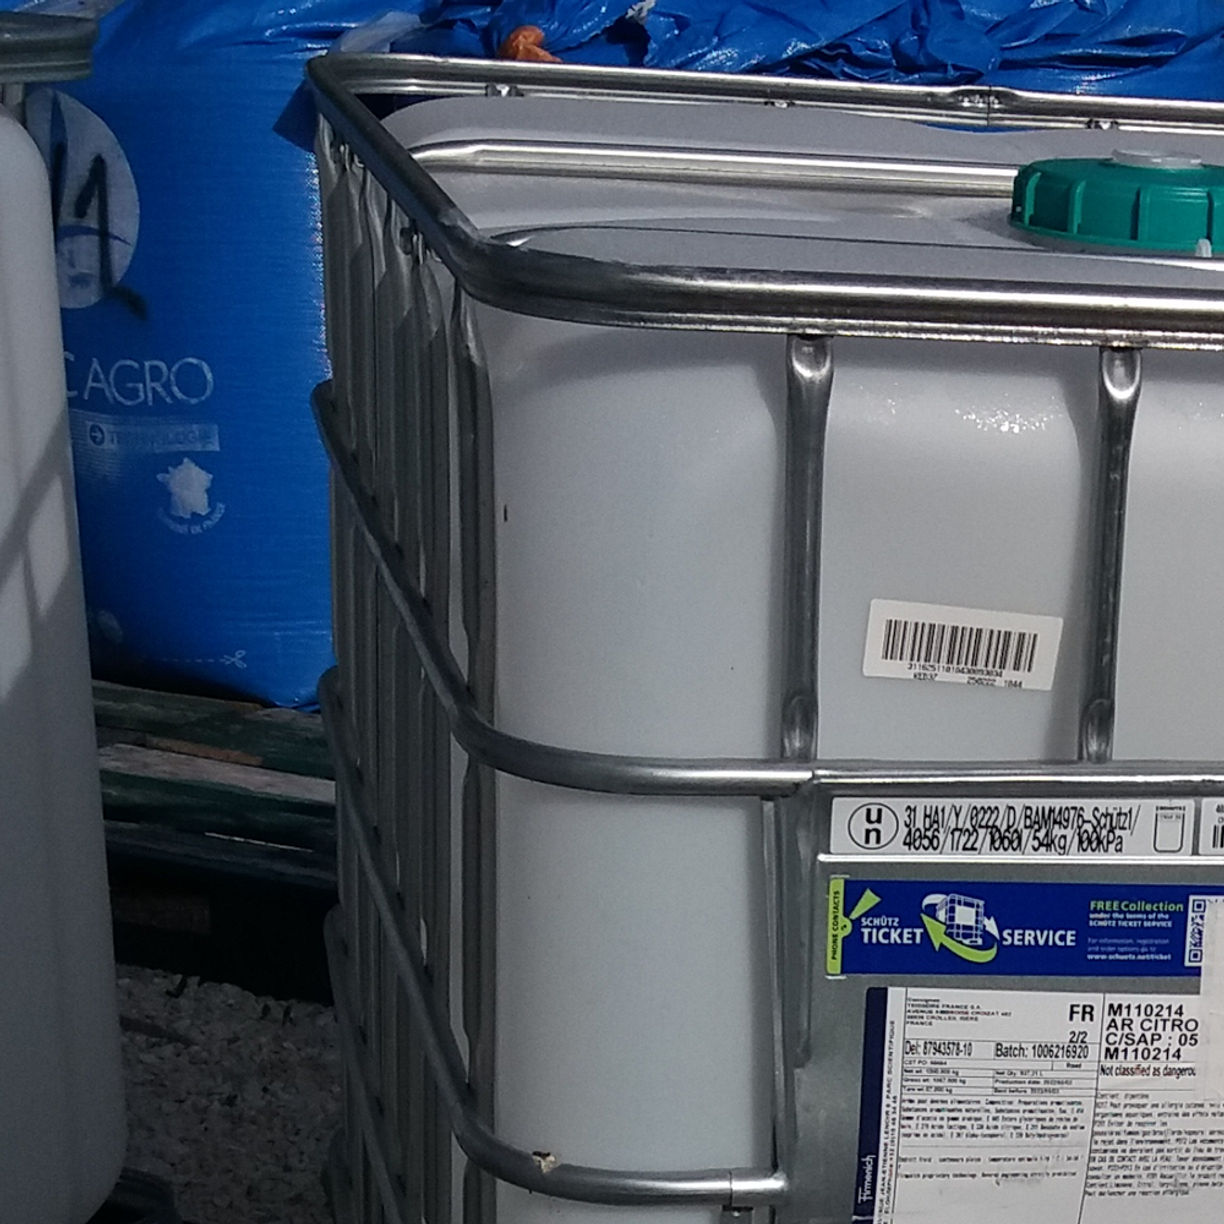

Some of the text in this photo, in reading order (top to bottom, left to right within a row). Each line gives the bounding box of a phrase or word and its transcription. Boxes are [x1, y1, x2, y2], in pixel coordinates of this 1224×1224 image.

[84, 357, 214, 406] AGRO
[904, 805, 917, 828] 31
[832, 890, 840, 932] CONTACTS
[1090, 900, 1183, 911] FREE Collection
[861, 915, 899, 926] SCHÜTZ
[861, 928, 924, 944] TICKET
[1002, 929, 1076, 946] SERVICE
[1069, 1004, 1094, 1022] FR
[1107, 1003, 1184, 1017] M110214
[1106, 1019, 1199, 1032] AR CITRO
[1069, 1031, 1088, 1044] 2/2
[1105, 1032, 1162, 1046] C/SAP
[1178, 1033, 1199, 1046] 05
[995, 1043, 1089, 1059] Batch: 1006216920
[1103, 1047, 1181, 1060] M110214
[1100, 1064, 1114, 1076] Not
[1115, 1064, 1150, 1077] classified
[1152, 1066, 1161, 1076] as
